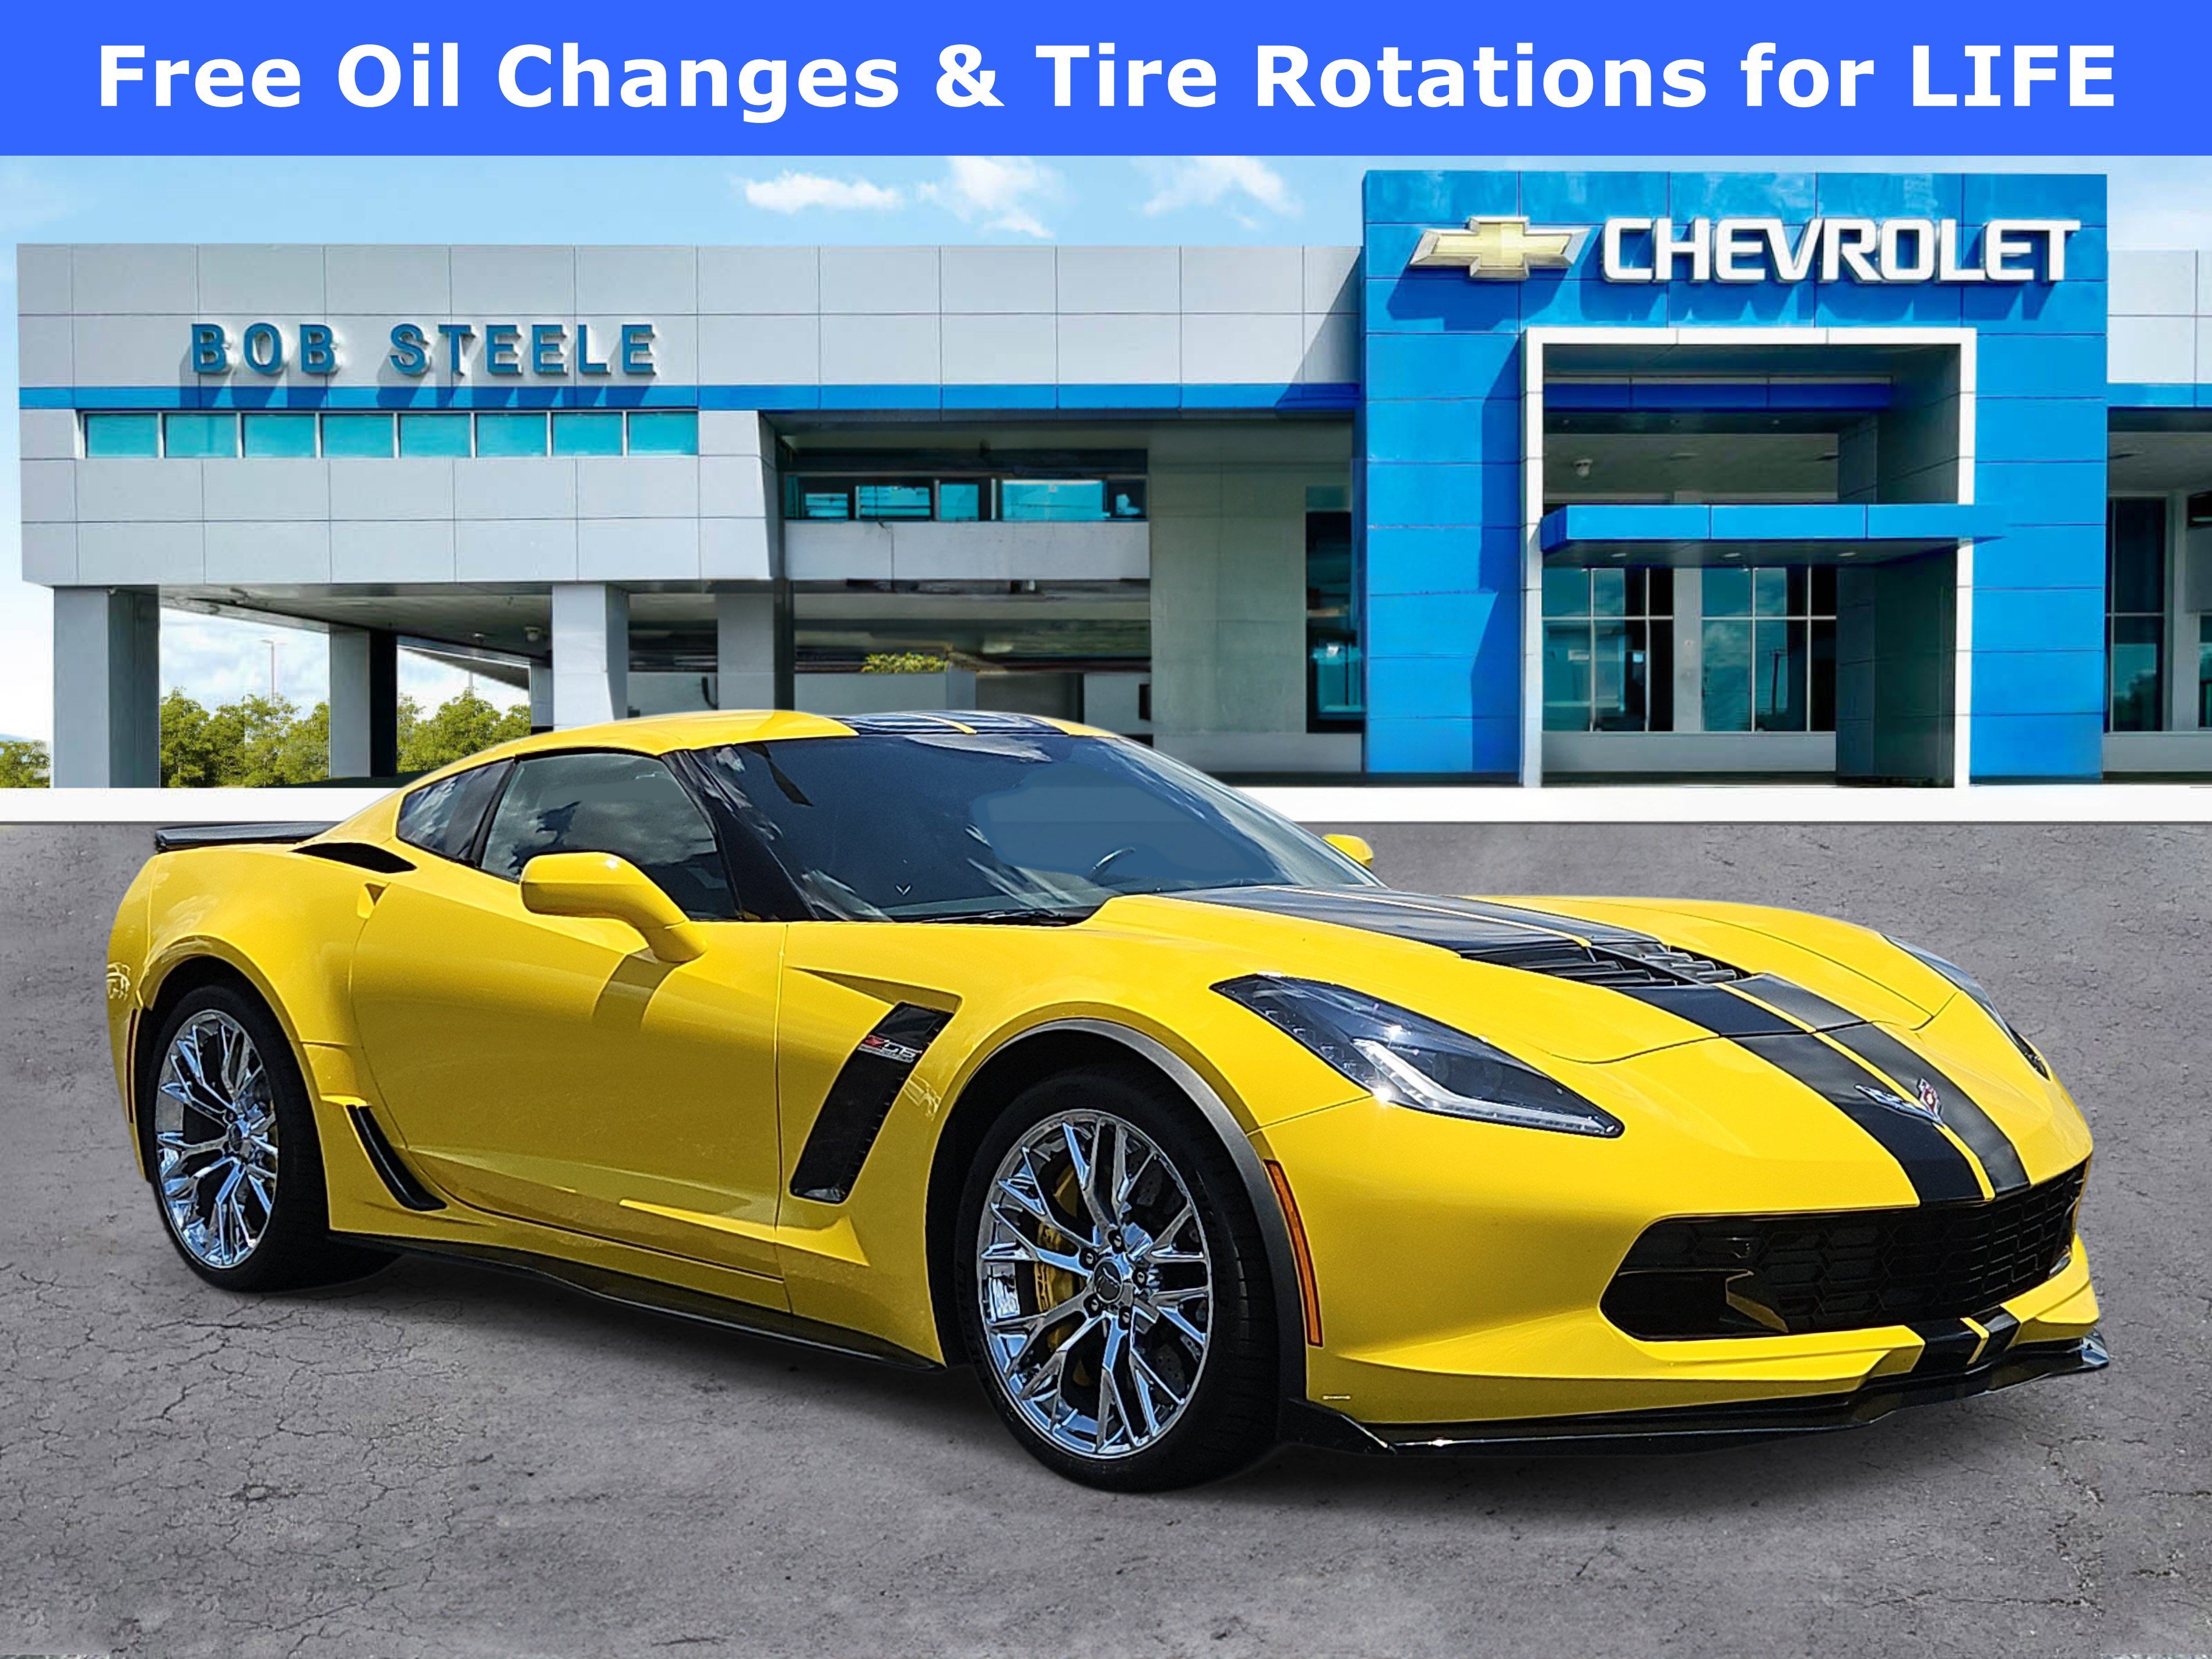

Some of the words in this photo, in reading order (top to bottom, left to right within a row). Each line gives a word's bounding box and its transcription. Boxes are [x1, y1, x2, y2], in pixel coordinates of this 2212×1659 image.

[1602, 217, 2081, 283] CHEVROLET
[191, 322, 340, 375] BOB
[389, 322, 657, 376] STEELE
